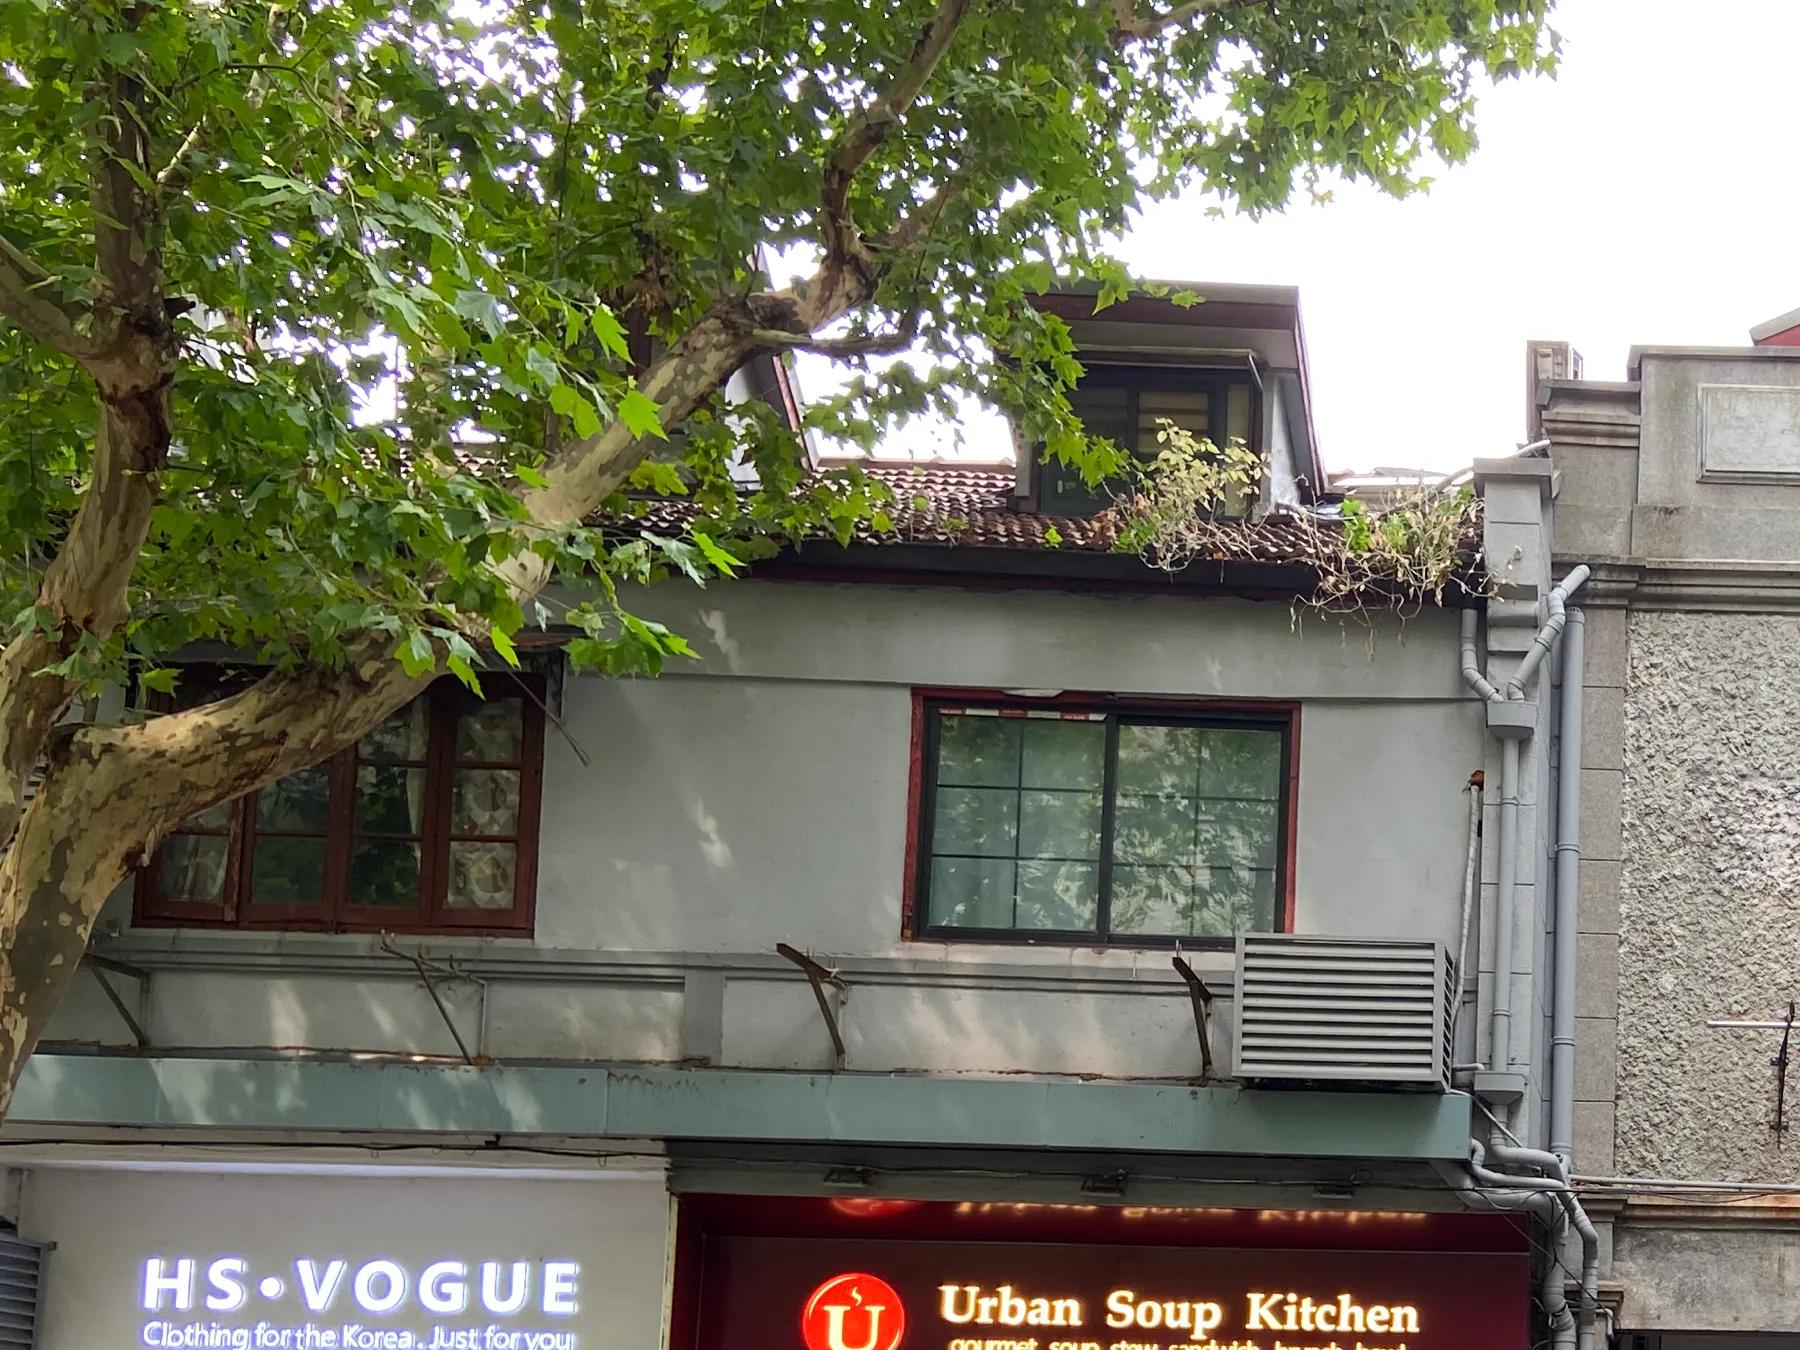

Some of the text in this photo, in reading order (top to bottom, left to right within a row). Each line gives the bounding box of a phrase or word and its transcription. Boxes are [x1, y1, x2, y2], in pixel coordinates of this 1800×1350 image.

[938, 1284, 1420, 1338] Urban Soup Kitchen
[254, 1323, 292, 1350] for
[295, 1325, 338, 1350] the
